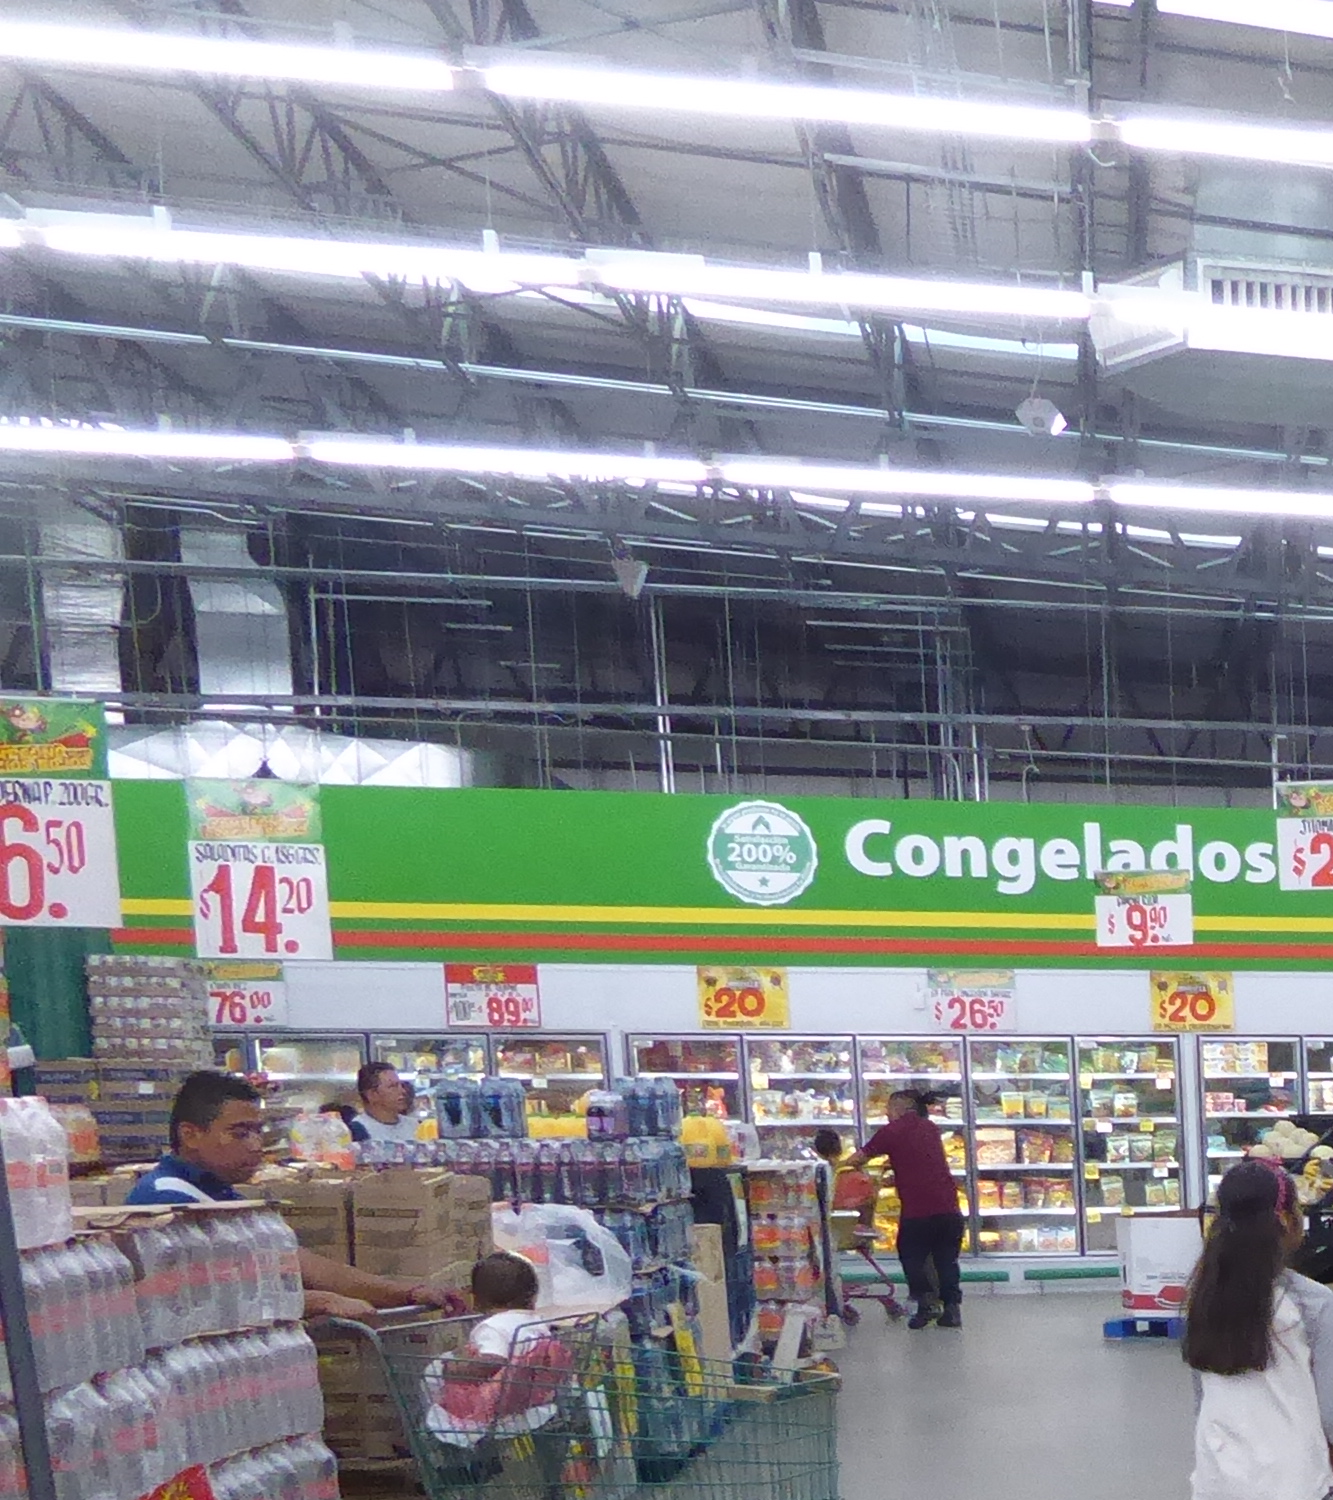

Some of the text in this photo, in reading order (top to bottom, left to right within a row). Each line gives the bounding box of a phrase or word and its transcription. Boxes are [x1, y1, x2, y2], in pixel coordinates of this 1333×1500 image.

[727, 843, 797, 863] 200%
[845, 818, 1276, 894] Congelados
[704, 988, 766, 1018] $20
[1160, 991, 1216, 1022] $20
